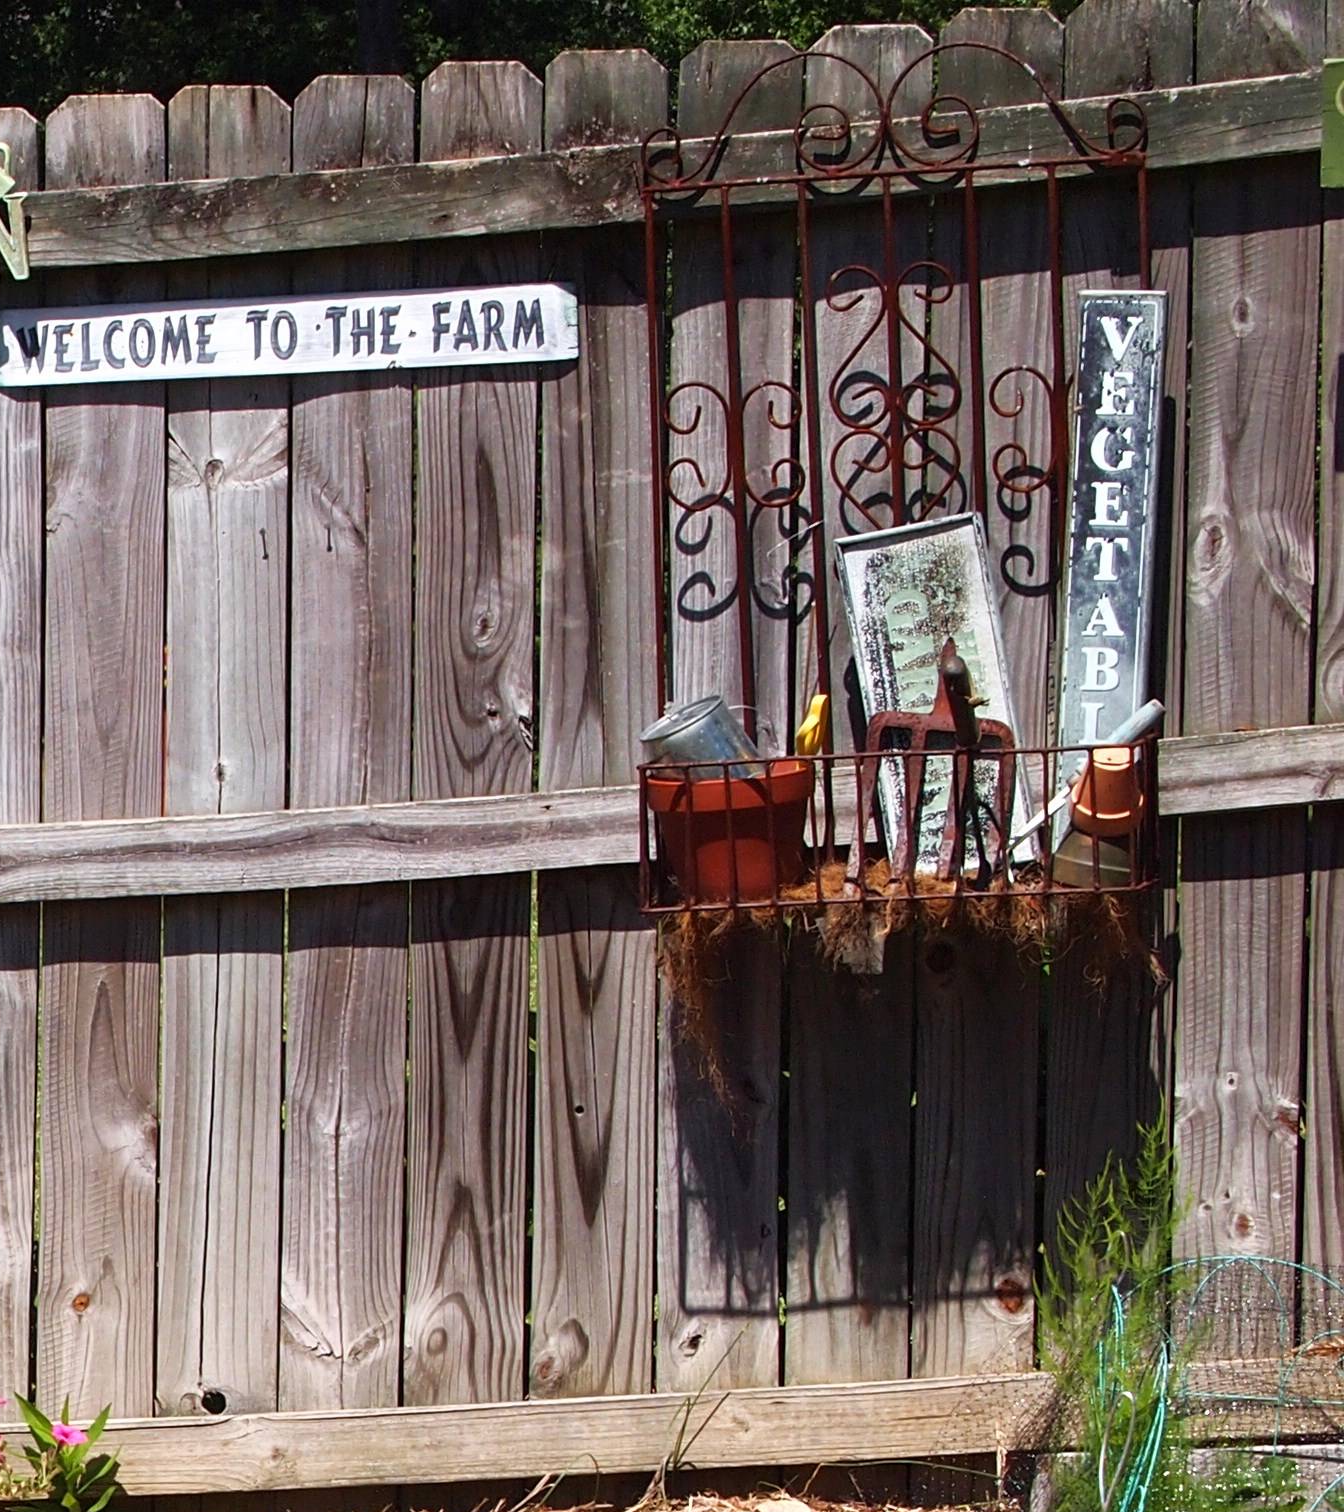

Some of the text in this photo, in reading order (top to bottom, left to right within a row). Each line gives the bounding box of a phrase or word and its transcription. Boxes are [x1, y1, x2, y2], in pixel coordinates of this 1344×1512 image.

[15, 297, 545, 376] WELCOME TO THE FARM
[1077, 315, 1144, 766] VEGETABL
